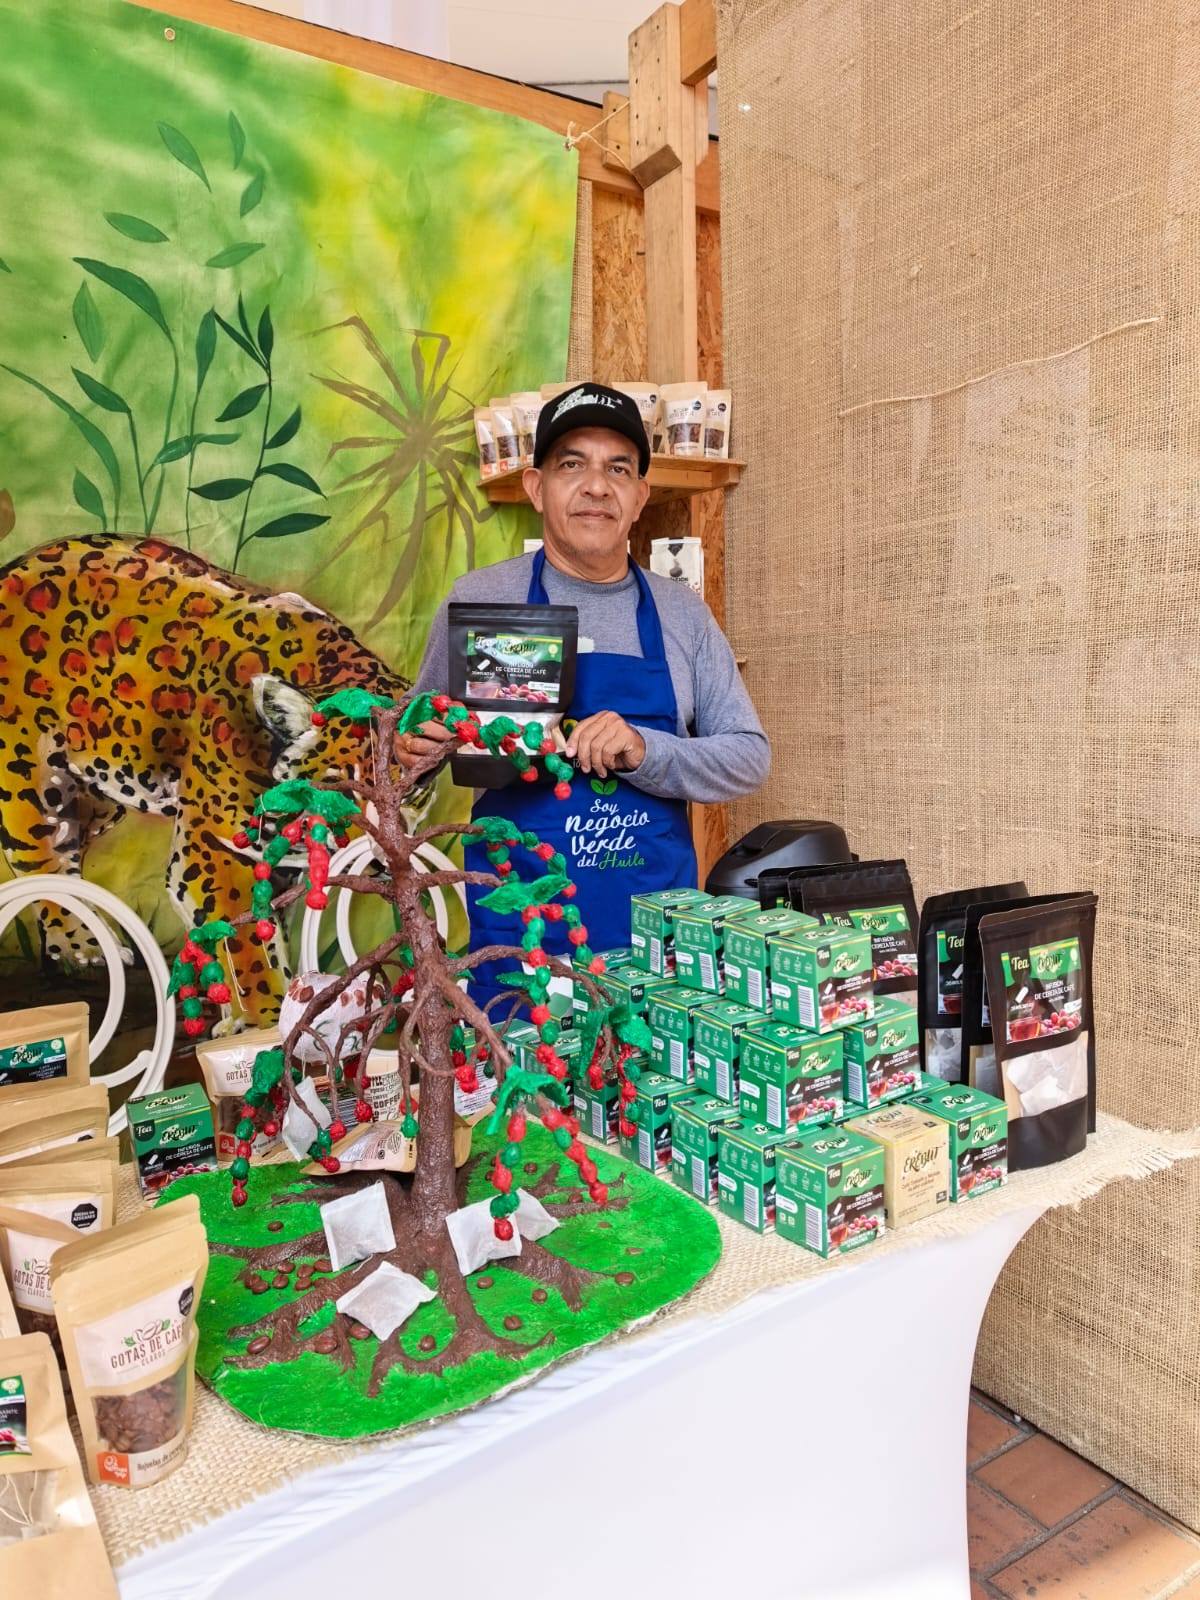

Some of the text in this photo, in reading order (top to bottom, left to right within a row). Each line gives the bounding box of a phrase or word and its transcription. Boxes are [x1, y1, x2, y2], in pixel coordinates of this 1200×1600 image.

[590, 799, 619, 815] Soy
[565, 809, 650, 838] Negocio
[571, 828, 637, 856] Verde
[577, 851, 645, 870] del Huila
[834, 917, 852, 927] Tea
[1011, 957, 1029, 971] Tea
[226, 1070, 248, 1081] GOTAS
[136, 1125, 153, 1137] Tea
[199, 1144, 213, 1152] CAFÉ
[13, 1269, 34, 1287] GOTAS
[35, 1274, 46, 1289] DE
[110, 1343, 146, 1369] GOTAS
[149, 1335, 162, 1353] DE
